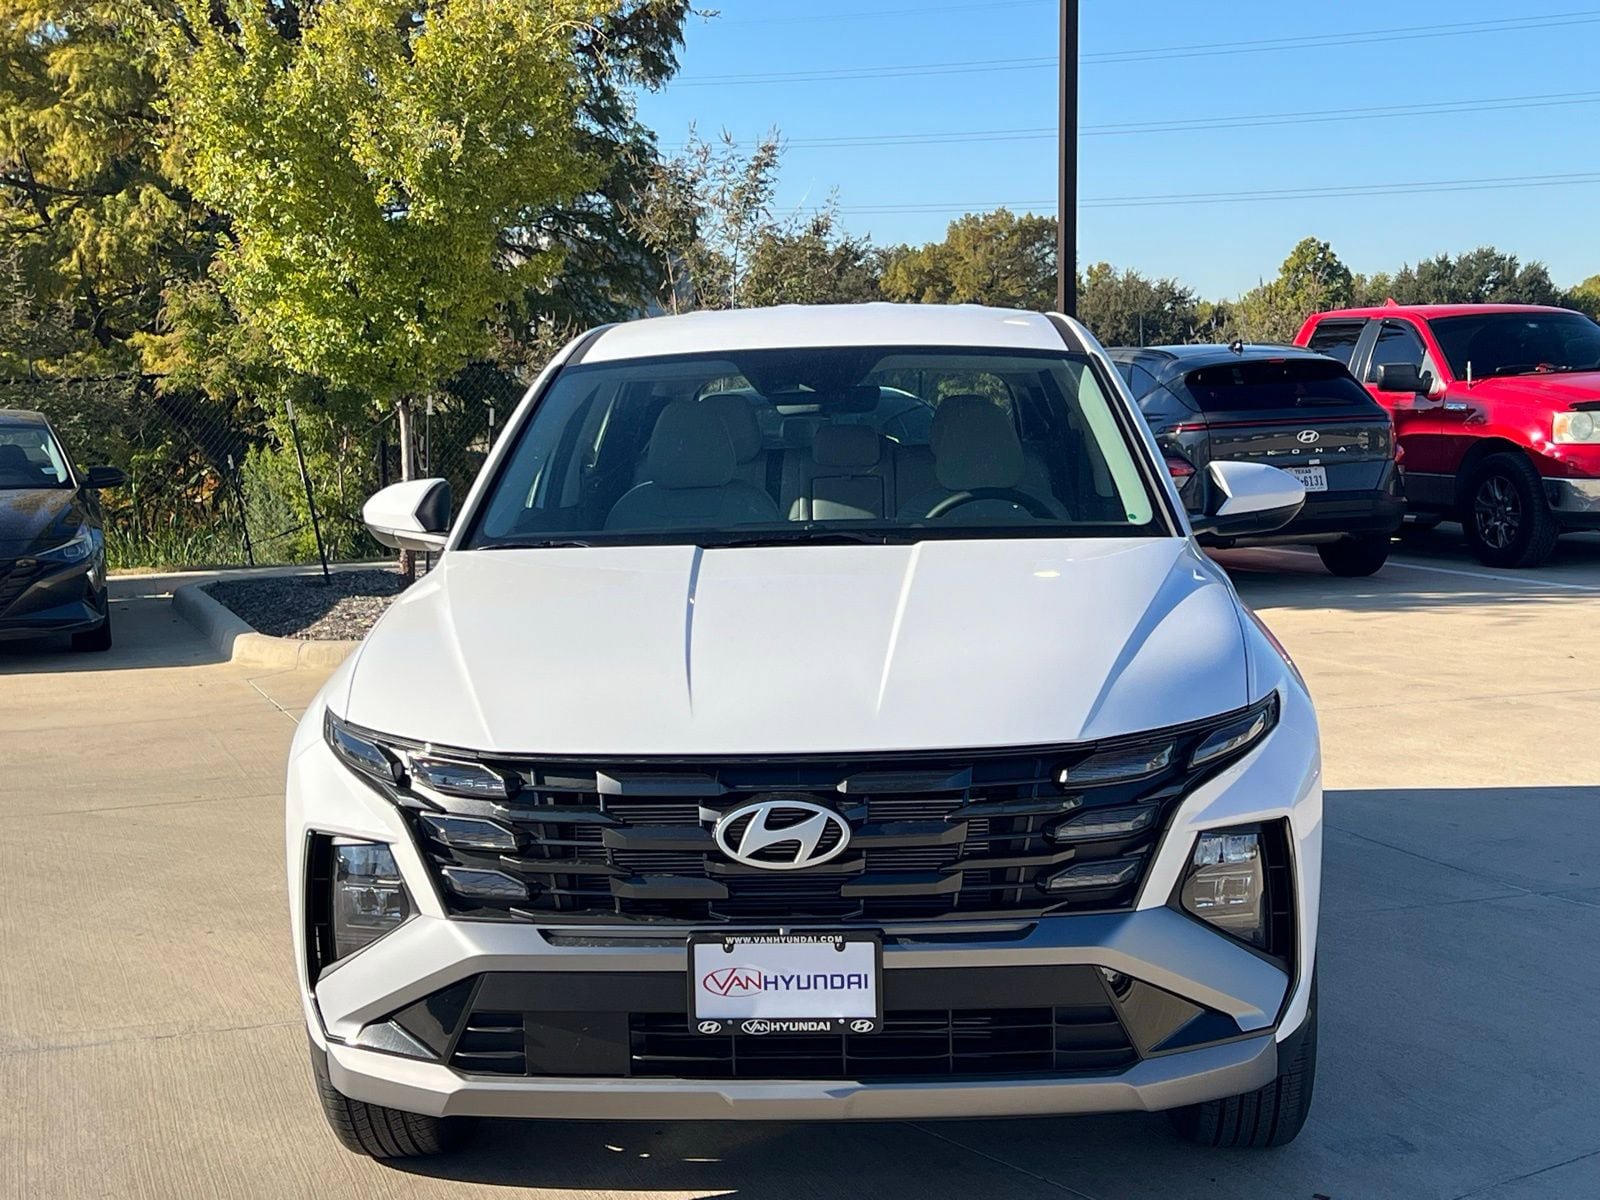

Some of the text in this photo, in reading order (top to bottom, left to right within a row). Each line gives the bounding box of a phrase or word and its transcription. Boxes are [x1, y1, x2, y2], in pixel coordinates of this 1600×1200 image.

[1267, 446, 1346, 456] KONA
[1303, 475, 1324, 487] 6131
[725, 936, 843, 944] WWW.VANHYUNDAI.COM
